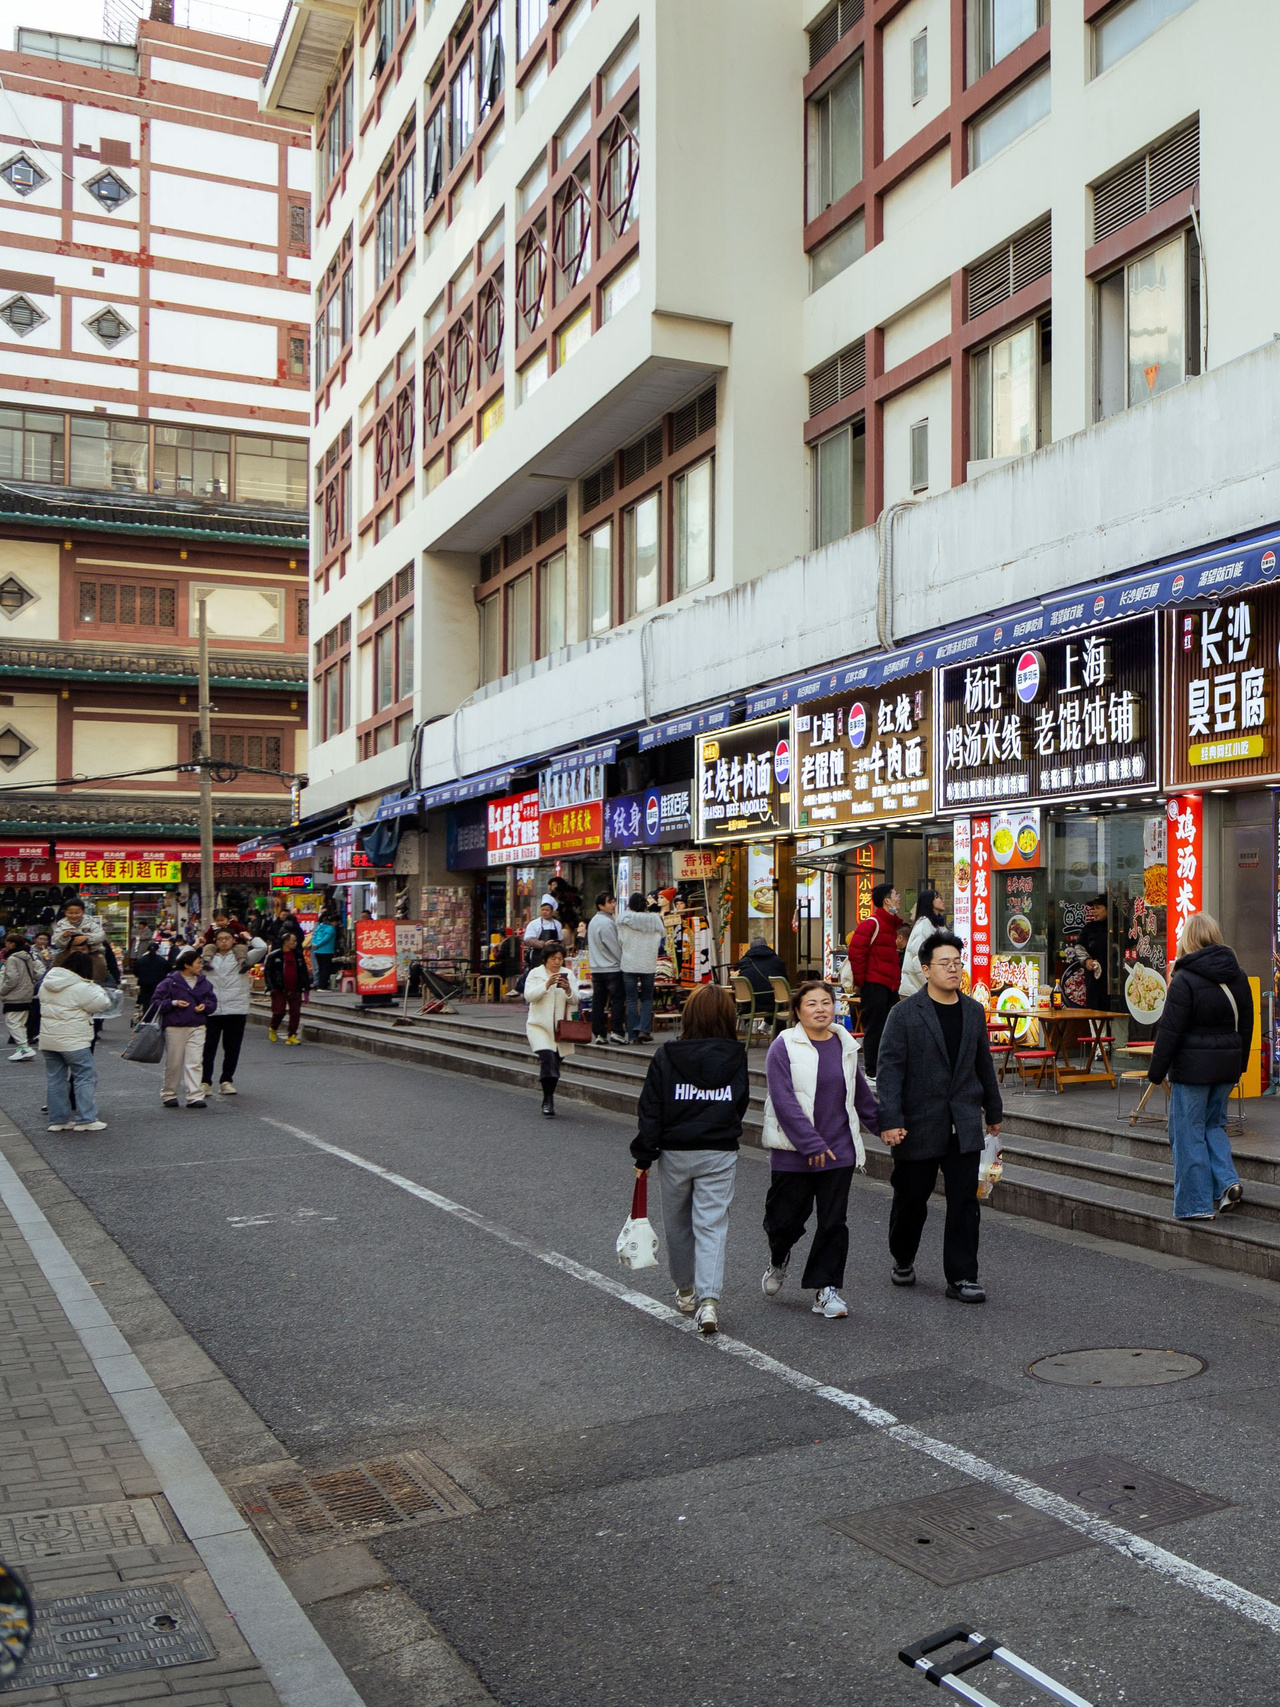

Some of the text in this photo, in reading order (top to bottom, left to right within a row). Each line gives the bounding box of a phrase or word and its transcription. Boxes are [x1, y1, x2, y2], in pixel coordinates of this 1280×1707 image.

[1198, 561, 1245, 587] 渴望就可能
[1119, 582, 1161, 606] 长沙臭豆腐
[1050, 603, 1085, 626] 渴望就可能
[1183, 617, 1193, 650] 网红
[1200, 600, 1252, 669] 长沙
[1017, 669, 1039, 685] 百事可乐
[1058, 635, 1107, 695] 上海
[964, 663, 1002, 714] 杨记
[877, 693, 912, 736] 红烧
[1188, 666, 1267, 738] 臭豆腐
[809, 712, 835, 748] 上海
[1034, 690, 1135, 757] 老馄饨铺
[945, 714, 1022, 771] 鸡汤米线
[1200, 741, 1250, 762] 经典网红小吃
[801, 747, 845, 791] 老馄饨
[870, 736, 924, 785] 牛肉面
[703, 750, 771, 803] 红烧牛肉面
[613, 801, 641, 839] 纹身
[726, 802, 740, 818] BEEF
[740, 797, 768, 816] NOODLES
[954, 838, 970, 849] 牛肉面
[5, 858, 46, 872] 特产
[65, 861, 169, 879] 便民便利超市
[681, 868, 698, 877] 饮料
[684, 852, 712, 867] 香烟
[4, 872, 52, 883] 全国包邮
[971, 820, 989, 926] 上海小笼包
[357, 928, 391, 940] 千里香
[991, 959, 1028, 984] 鸡汤米线
[674, 1083, 732, 1101] HIPANDA
